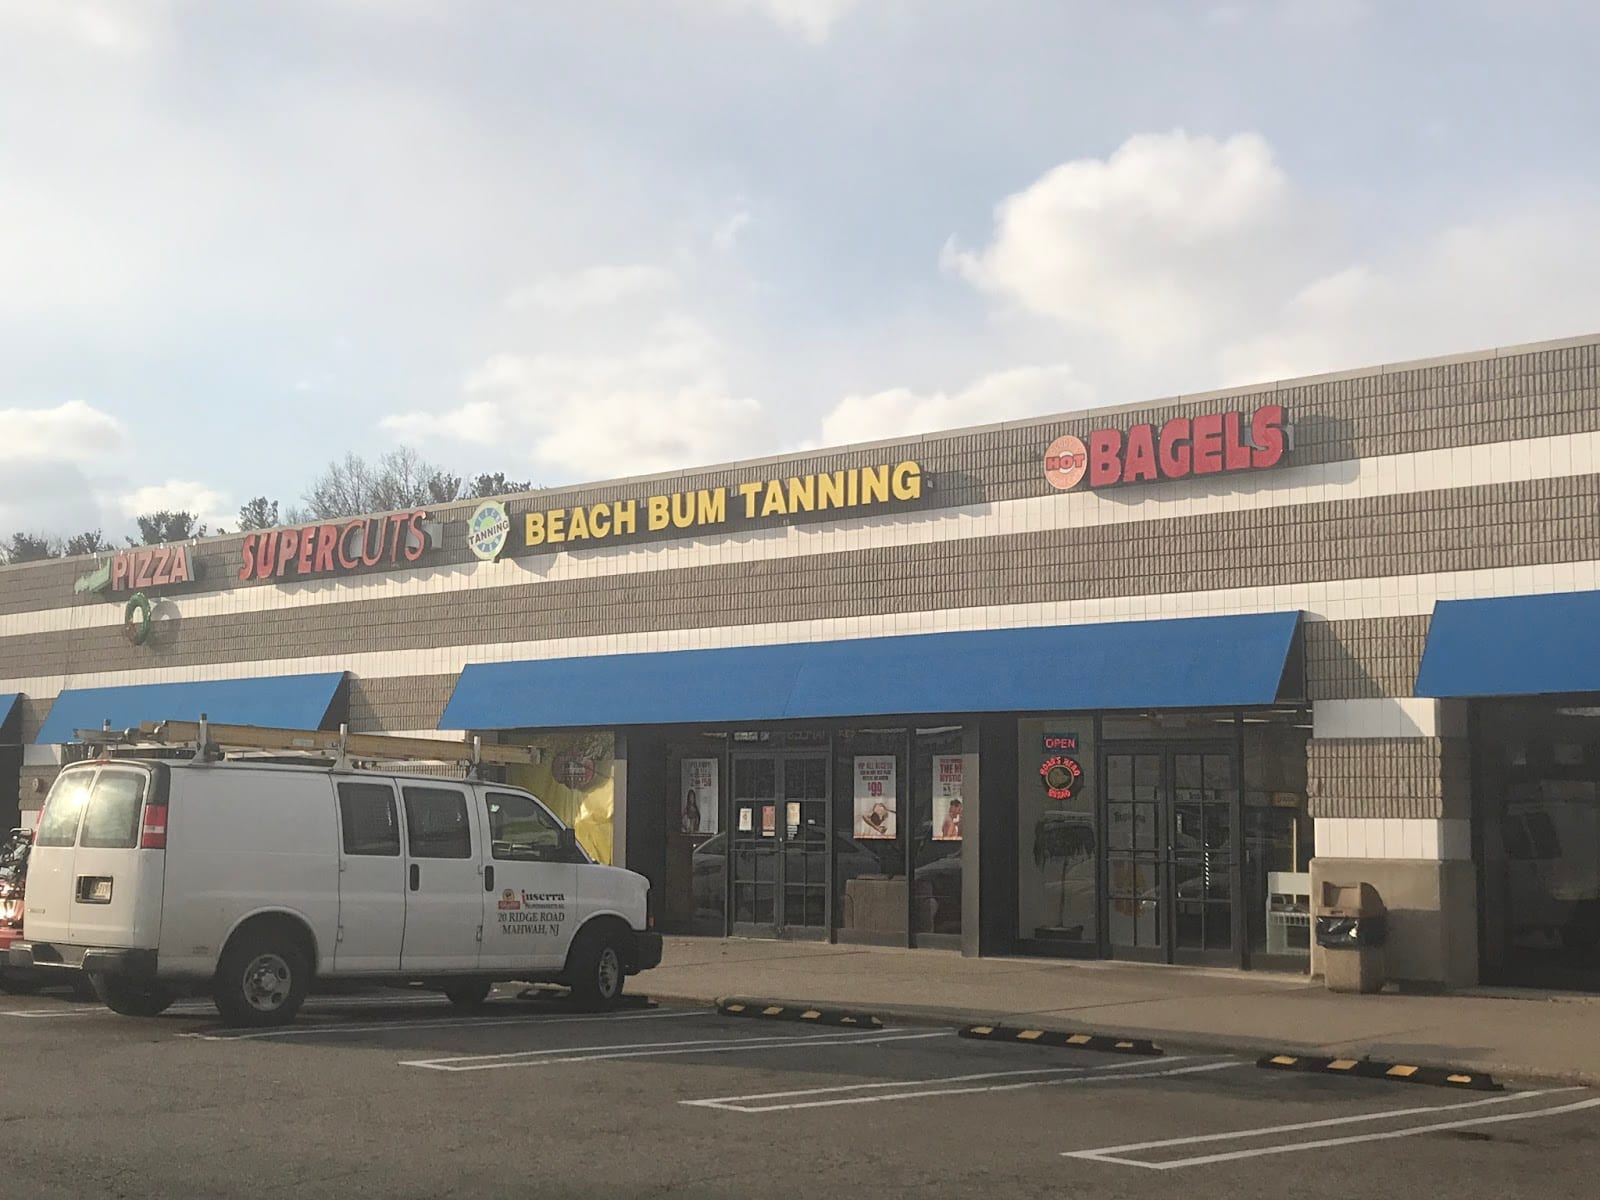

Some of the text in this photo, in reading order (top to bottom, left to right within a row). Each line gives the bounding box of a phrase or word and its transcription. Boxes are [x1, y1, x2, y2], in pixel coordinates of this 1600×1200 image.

[1046, 404, 1283, 487] HOT BAGELS
[525, 500, 636, 546] BEACH
[648, 487, 726, 530] BUM
[740, 460, 922, 519] TANNING
[239, 510, 427, 581] SUPERCUTS
[468, 520, 509, 545] TANNING
[112, 546, 190, 591] PIZZA
[1045, 738, 1076, 749] OPEN
[509, 912, 538, 922] RIDGE
[540, 912, 565, 922] ROAD
[550, 924, 560, 937] NJ
